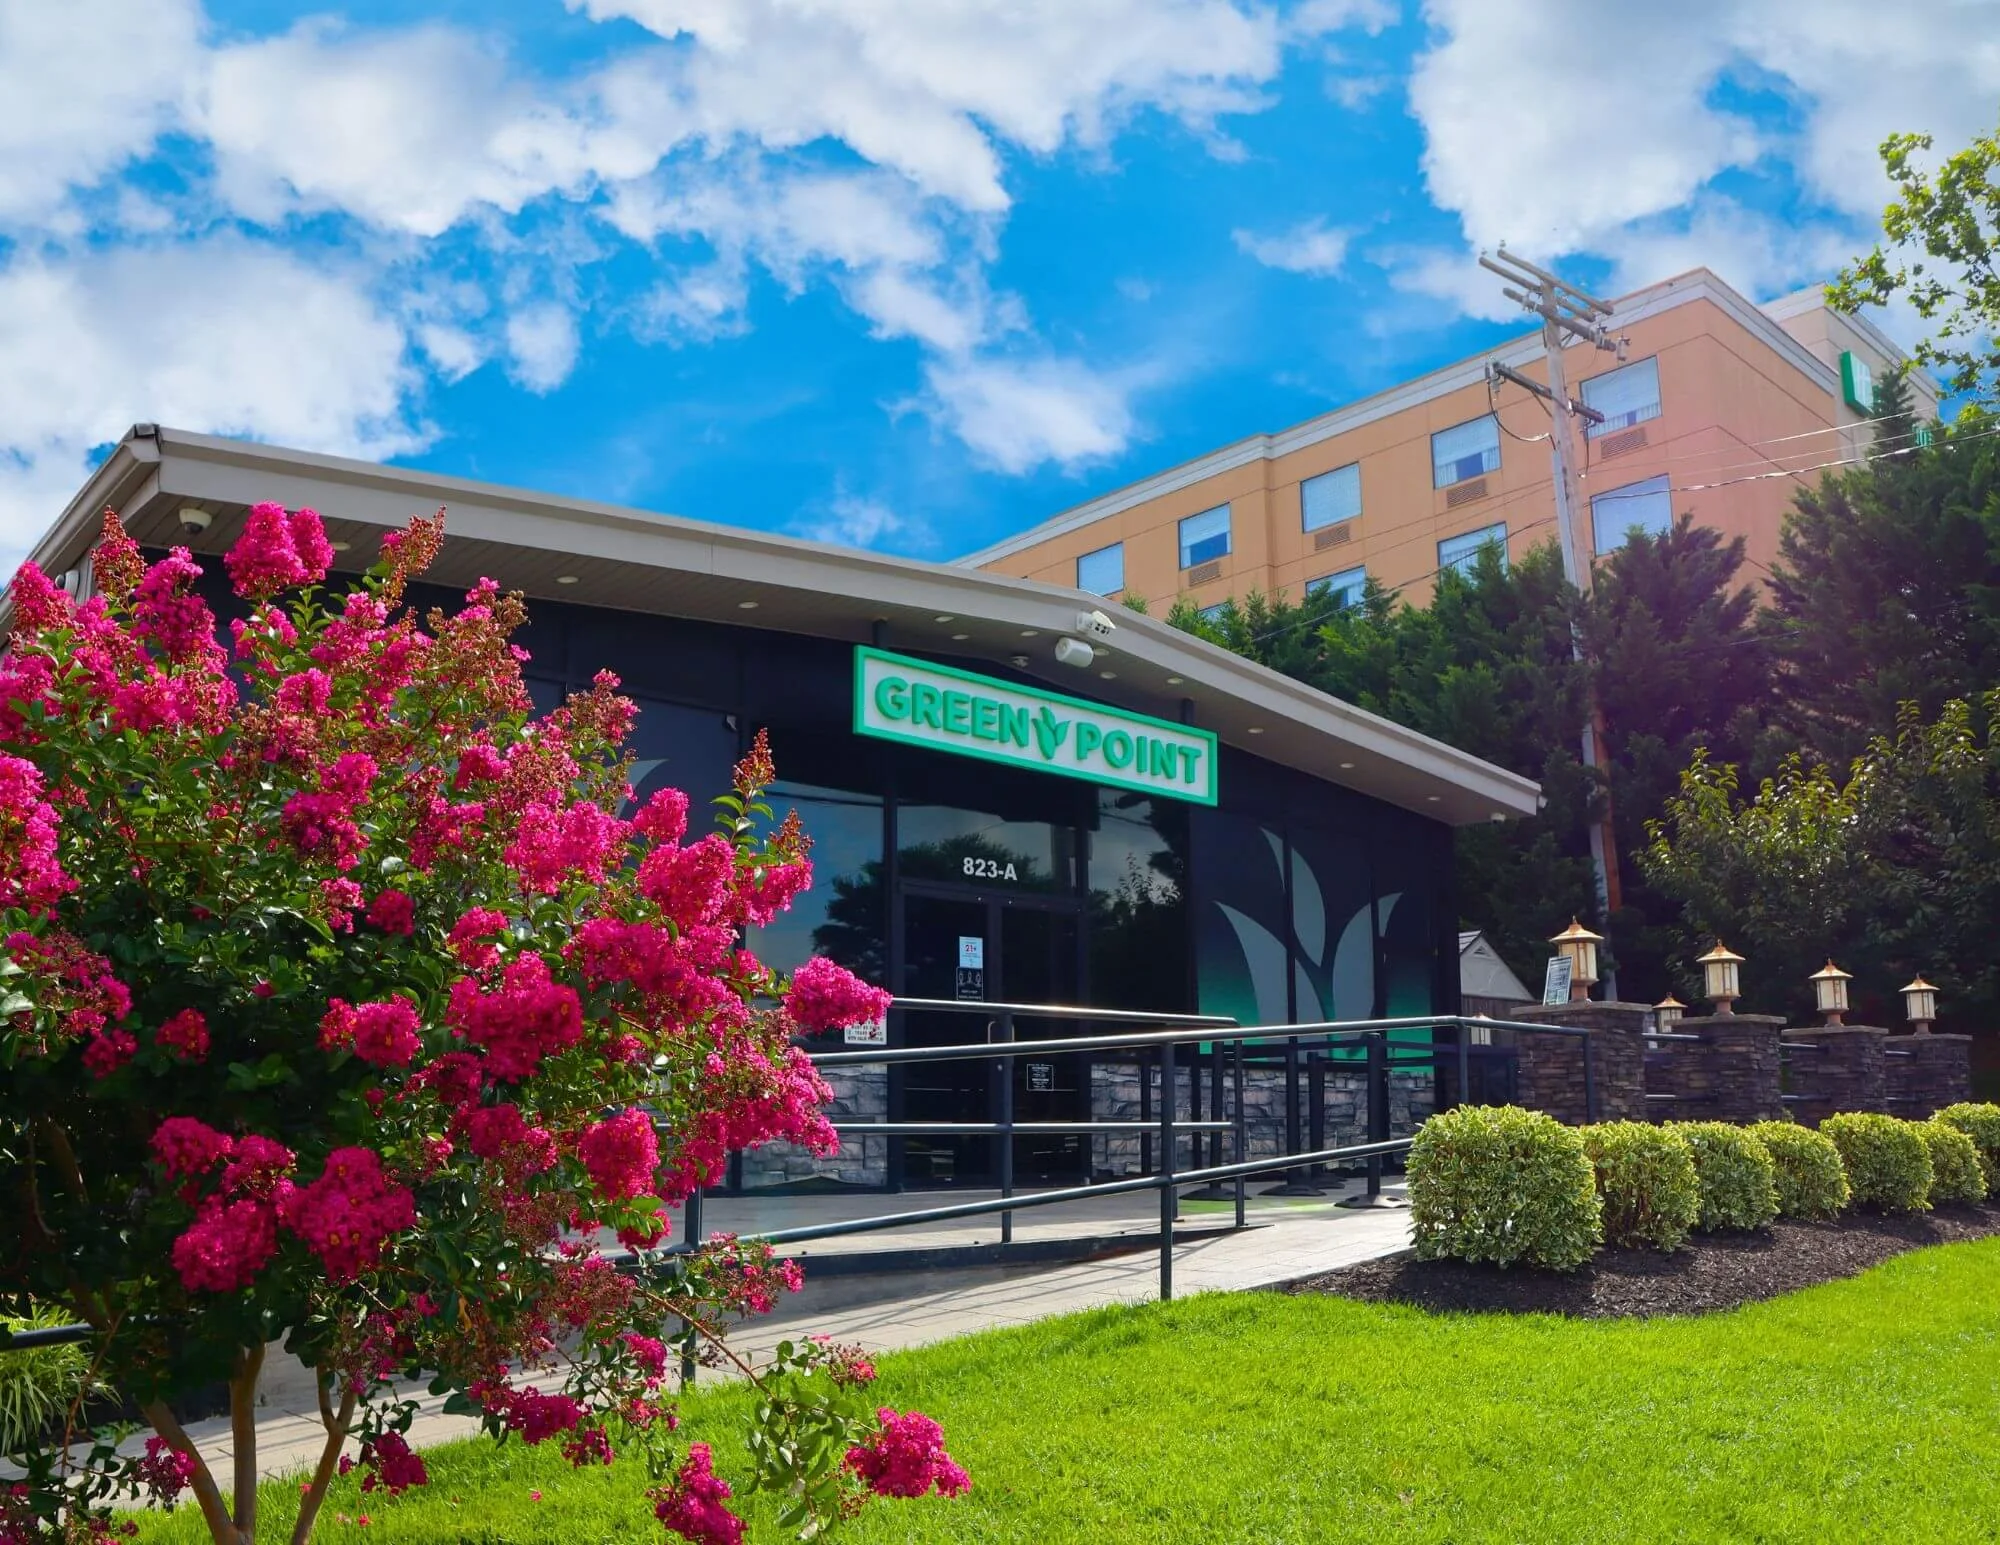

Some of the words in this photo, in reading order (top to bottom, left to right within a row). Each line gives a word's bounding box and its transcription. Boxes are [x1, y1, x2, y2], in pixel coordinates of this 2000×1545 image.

[874, 676, 1029, 748] GREEN
[1076, 721, 1202, 784] POINT
[963, 856, 1018, 881] 823-A
